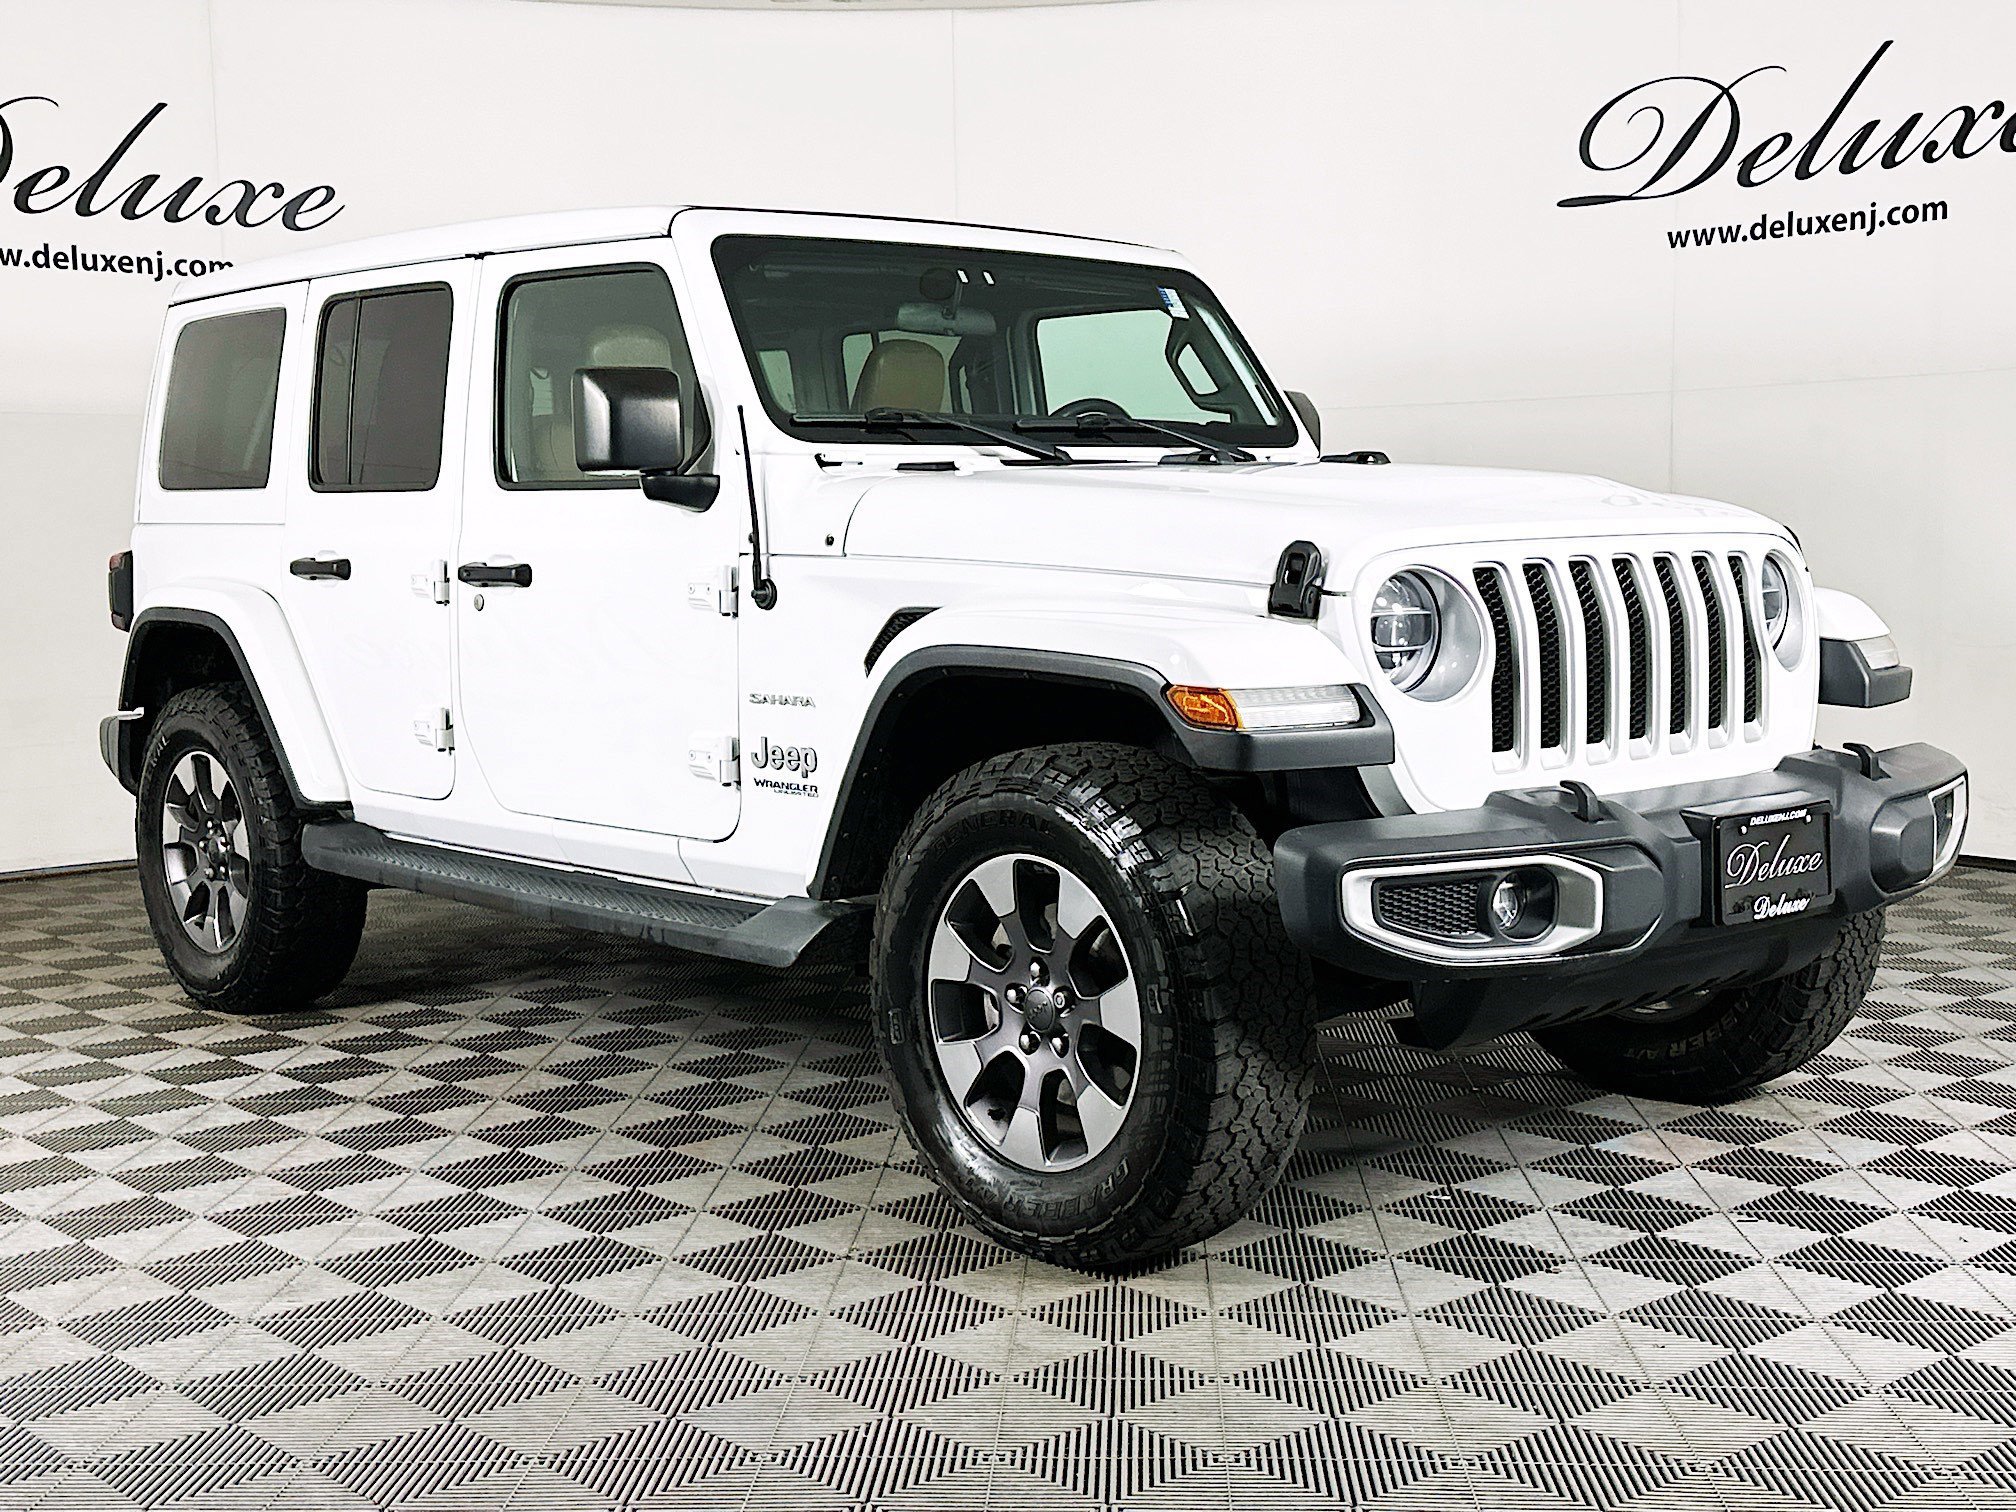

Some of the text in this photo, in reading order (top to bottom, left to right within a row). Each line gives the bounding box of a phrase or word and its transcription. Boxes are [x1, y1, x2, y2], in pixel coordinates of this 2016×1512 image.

[0, 96, 345, 231] eluxe
[1667, 200, 1948, 249] www.deluxenj.com
[749, 693, 816, 708] SAHARA
[751, 736, 818, 779] Jeep
[753, 777, 818, 793] WRANGLER
[930, 809, 1057, 858] GENERAL
[1724, 834, 1823, 889] Deluxe
[1753, 893, 1811, 920] Deluxe
